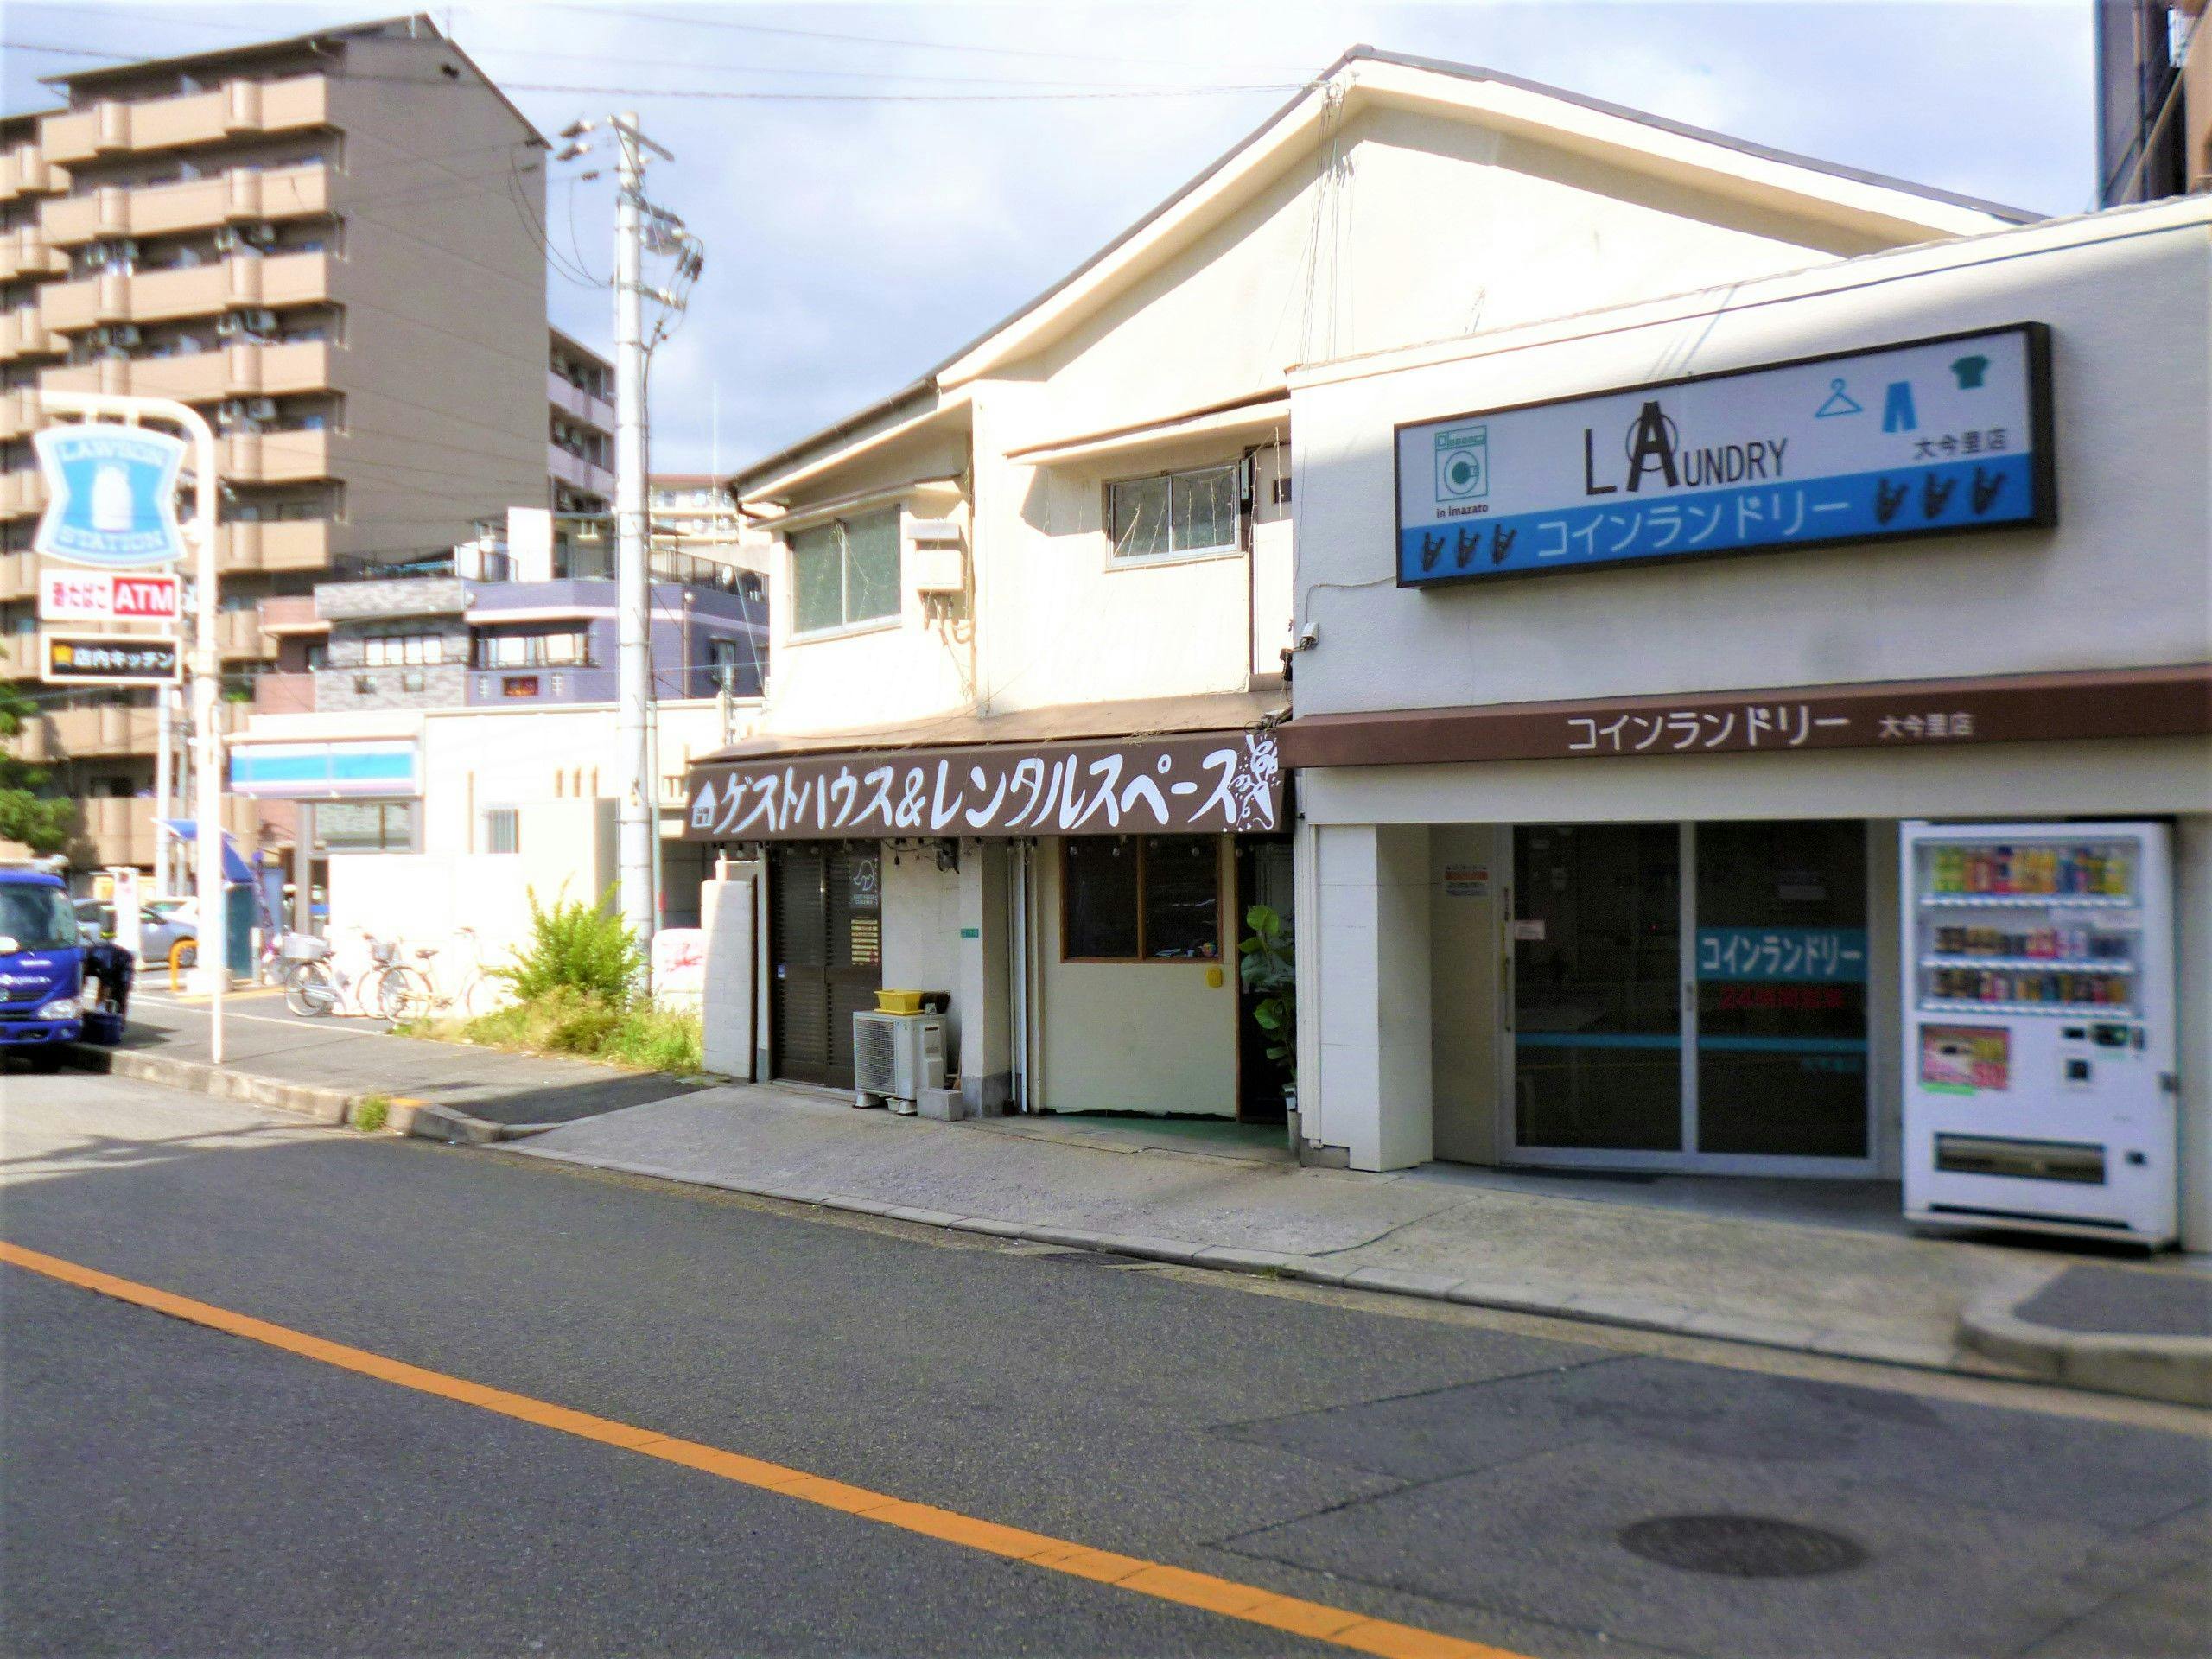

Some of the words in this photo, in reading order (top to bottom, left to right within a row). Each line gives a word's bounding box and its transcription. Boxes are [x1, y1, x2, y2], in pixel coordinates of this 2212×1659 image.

[1437, 507, 1446, 518] in
[1448, 503, 1489, 517] Imazato
[1538, 489, 1849, 558] コインランドリー
[116, 583, 174, 611] ATM
[1567, 704, 1849, 751] コインランドリー
[714, 748, 1237, 835] ゲストハウス&レンタルスペース
[1701, 934, 1864, 976] コインランドリー
